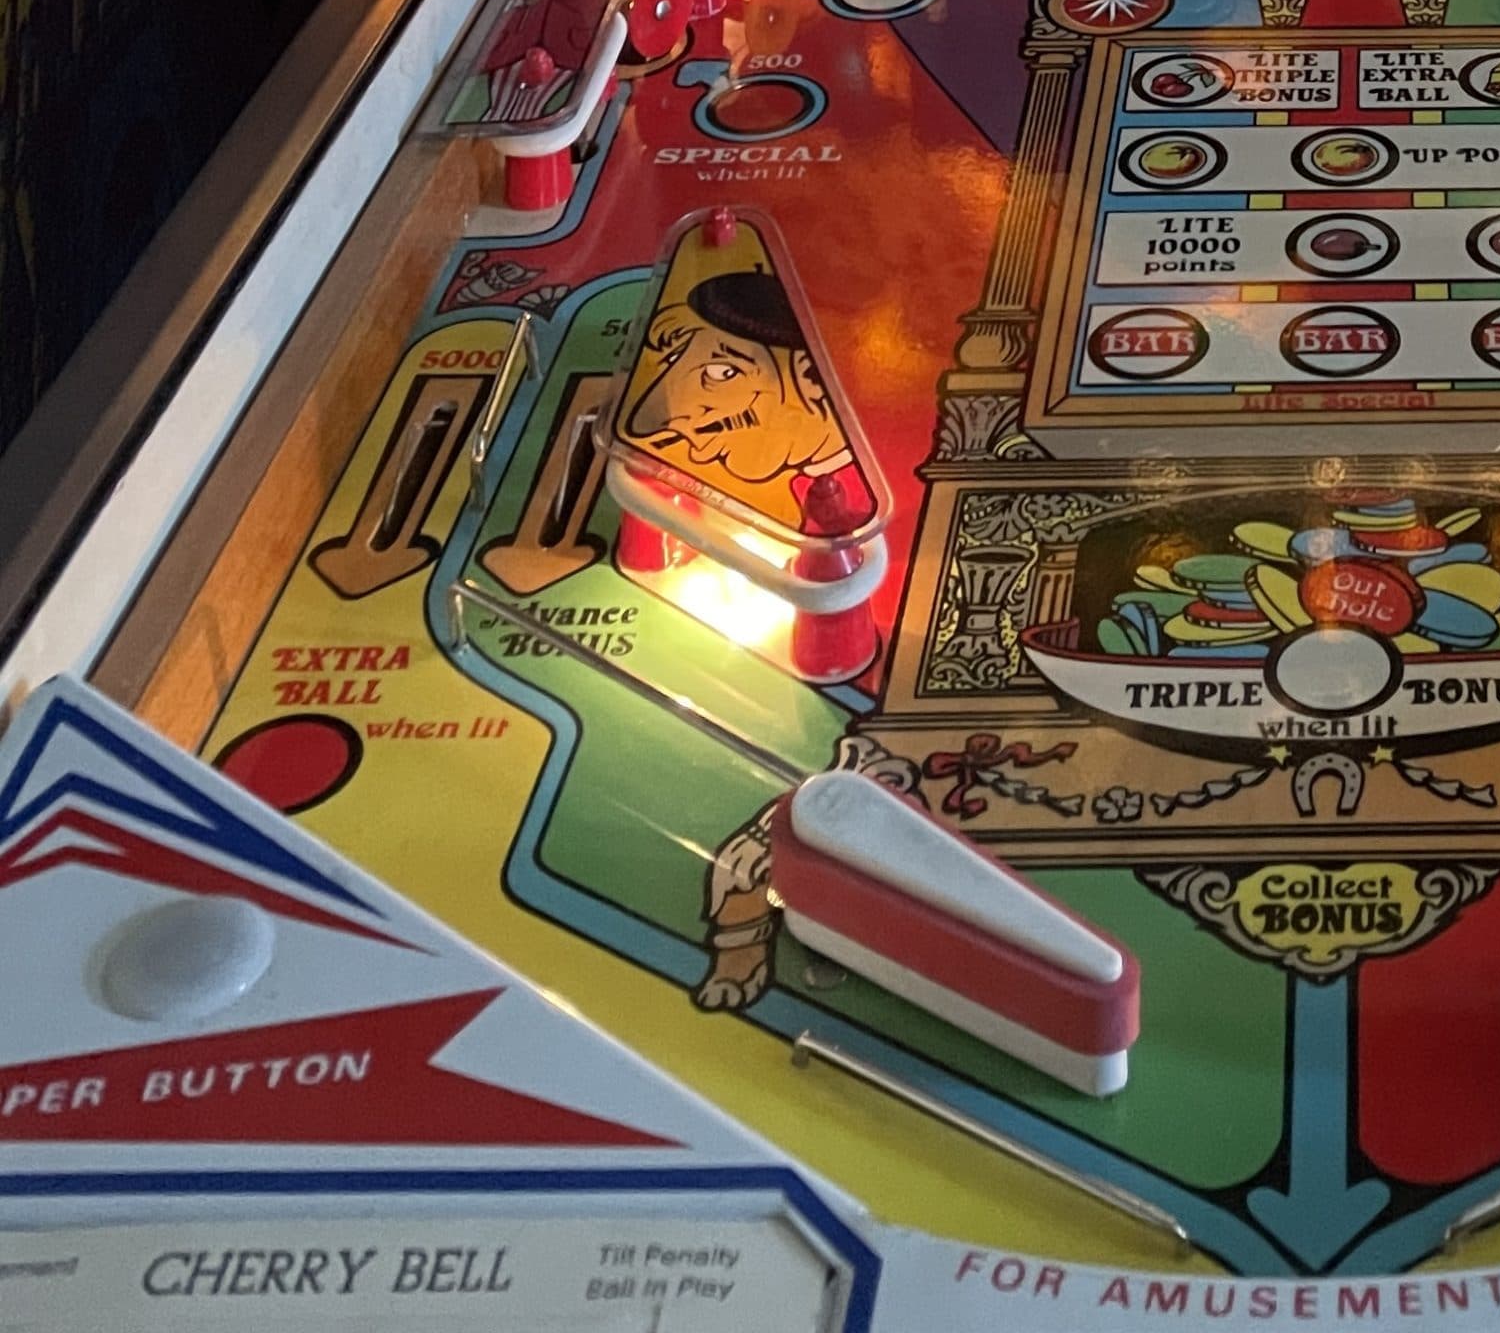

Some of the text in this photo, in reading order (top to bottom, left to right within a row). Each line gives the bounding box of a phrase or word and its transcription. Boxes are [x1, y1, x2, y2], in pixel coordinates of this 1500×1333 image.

[747, 53, 803, 70] 500
[1251, 52, 1320, 68] LITE
[1373, 51, 1446, 67] LITE
[1238, 68, 1336, 85] TRIPLE
[1361, 67, 1459, 84] EXTRA
[1238, 88, 1332, 104] BONUS
[1374, 87, 1451, 104] BALL
[653, 145, 843, 165] SPECIAL
[1402, 147, 1450, 165] UP
[696, 165, 807, 182] when lit
[1156, 217, 1235, 234] LITE
[1147, 236, 1242, 257] 10000
[1142, 257, 1237, 277] points
[1103, 331, 1197, 355] BAR
[1294, 330, 1386, 354] BAR
[1332, 571, 1389, 597] Out
[1326, 591, 1396, 623] hole
[271, 645, 411, 672] EXTRA
[273, 679, 385, 707] BALL
[1124, 681, 1264, 710] TRIPLE
[365, 715, 511, 740] when lit
[1257, 715, 1399, 740] when lit
[1260, 873, 1394, 901] Collect
[1252, 901, 1404, 935] BONUS
[141, 1049, 373, 1104] BUTTON
[598, 1242, 741, 1270] Tilt Penalty
[141, 1245, 513, 1297] CHERRY BELL
[953, 1247, 1069, 1298] FOR
[675, 1274, 736, 1304] Play
